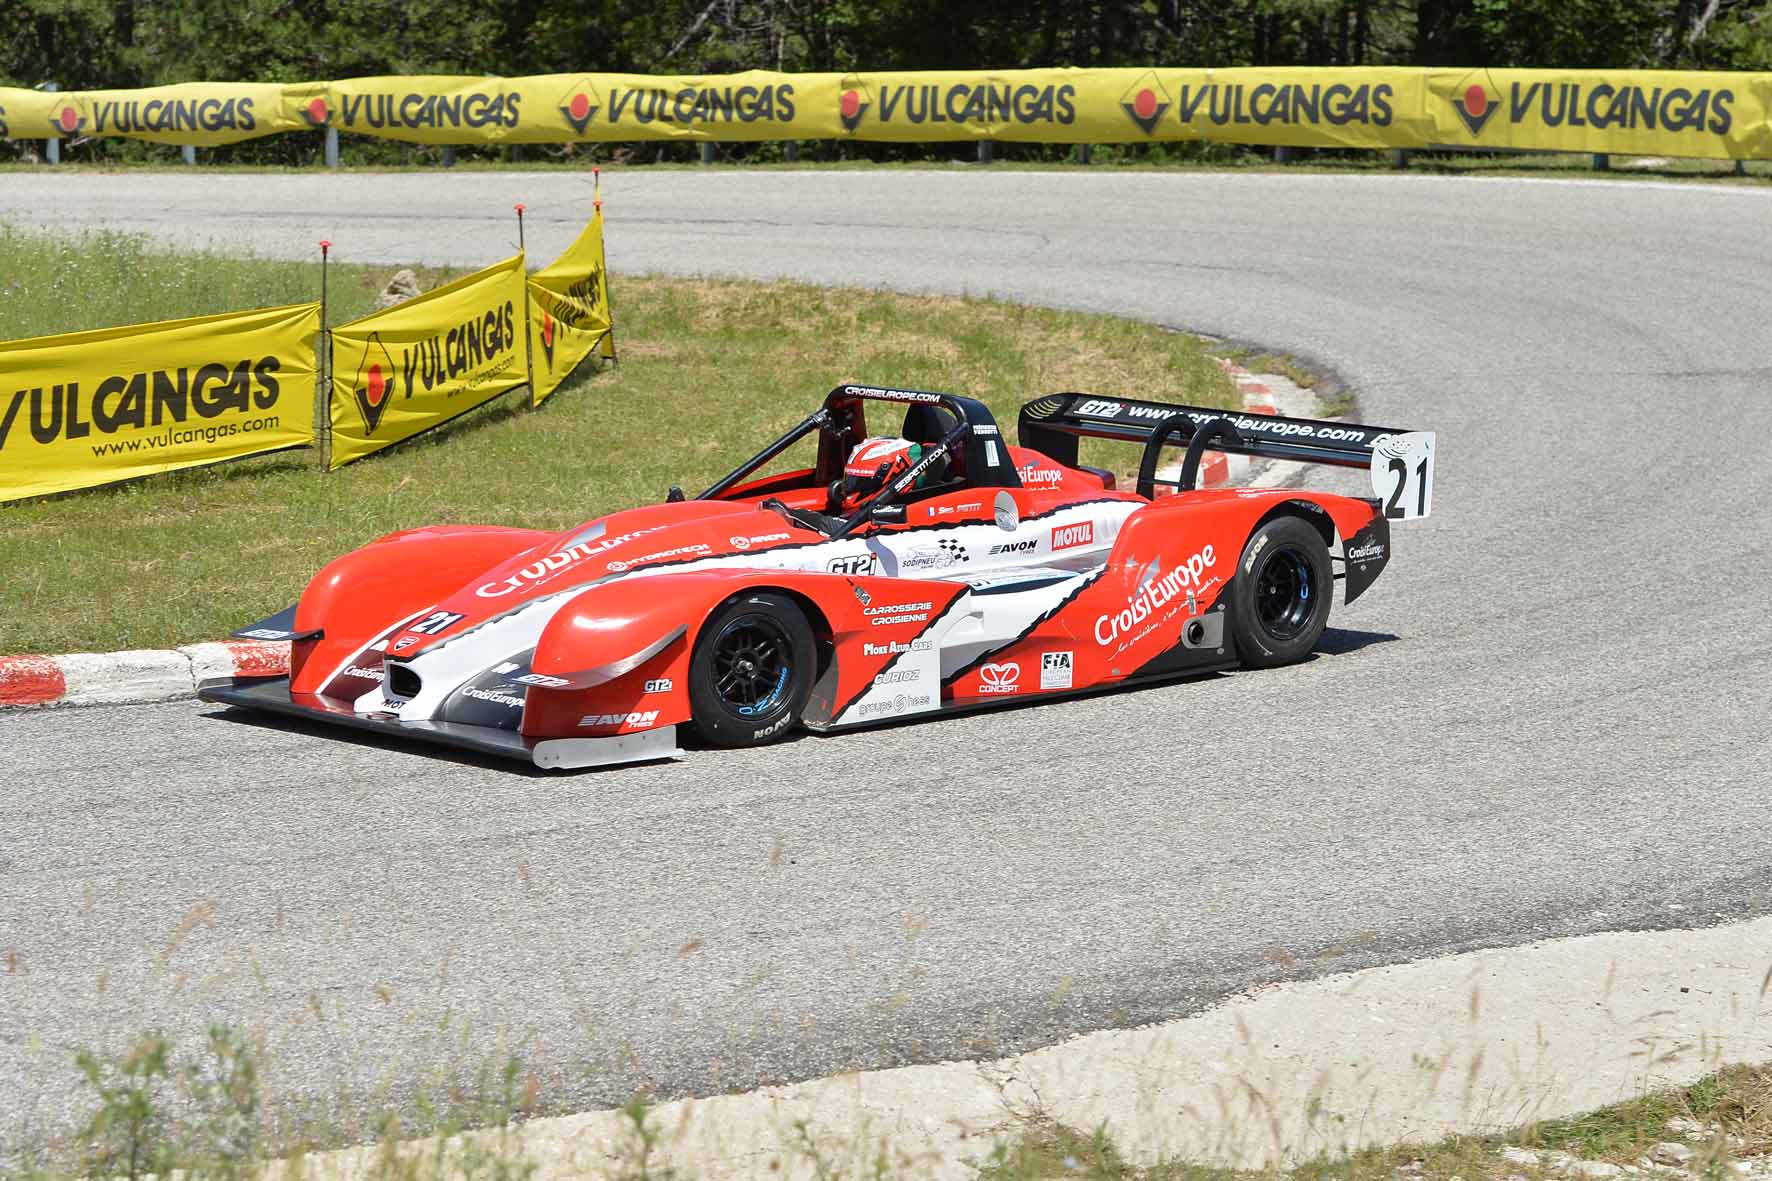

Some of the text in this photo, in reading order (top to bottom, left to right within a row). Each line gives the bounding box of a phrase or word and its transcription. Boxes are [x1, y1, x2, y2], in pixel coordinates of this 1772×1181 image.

[93, 97, 256, 133] VULCANGAS
[342, 92, 521, 128] VULCANGAS
[608, 83, 795, 124] VULCANGAS
[880, 84, 1076, 124] VULCANGAS
[1179, 84, 1393, 125] VULCANGAS
[1510, 82, 1735, 135] VULCANGAS
[403, 300, 513, 398] VULCANGAS
[844, 386, 941, 403] CROISIEUROPE.COM
[91, 416, 280, 457] www.vulcangas.com
[1384, 456, 1428, 520] 21
[999, 540, 1038, 554] AVON
[1053, 524, 1092, 548] MOTUL
[902, 557, 936, 568] SODIPNEU
[1349, 544, 1385, 560] CroisiEurope
[826, 552, 878, 577] GT2i
[1094, 544, 1217, 646] CroisiEurope
[863, 601, 933, 616] CARROSSERIE
[871, 613, 929, 626] CROISIENNE
[408, 611, 462, 635] 21
[1043, 653, 1070, 670] FIA
[642, 678, 673, 694] GT2i
[874, 668, 920, 684] CURIOZ
[979, 684, 1019, 693] CONCEPT
[596, 711, 660, 727] AVON
[753, 711, 791, 740] AVON
